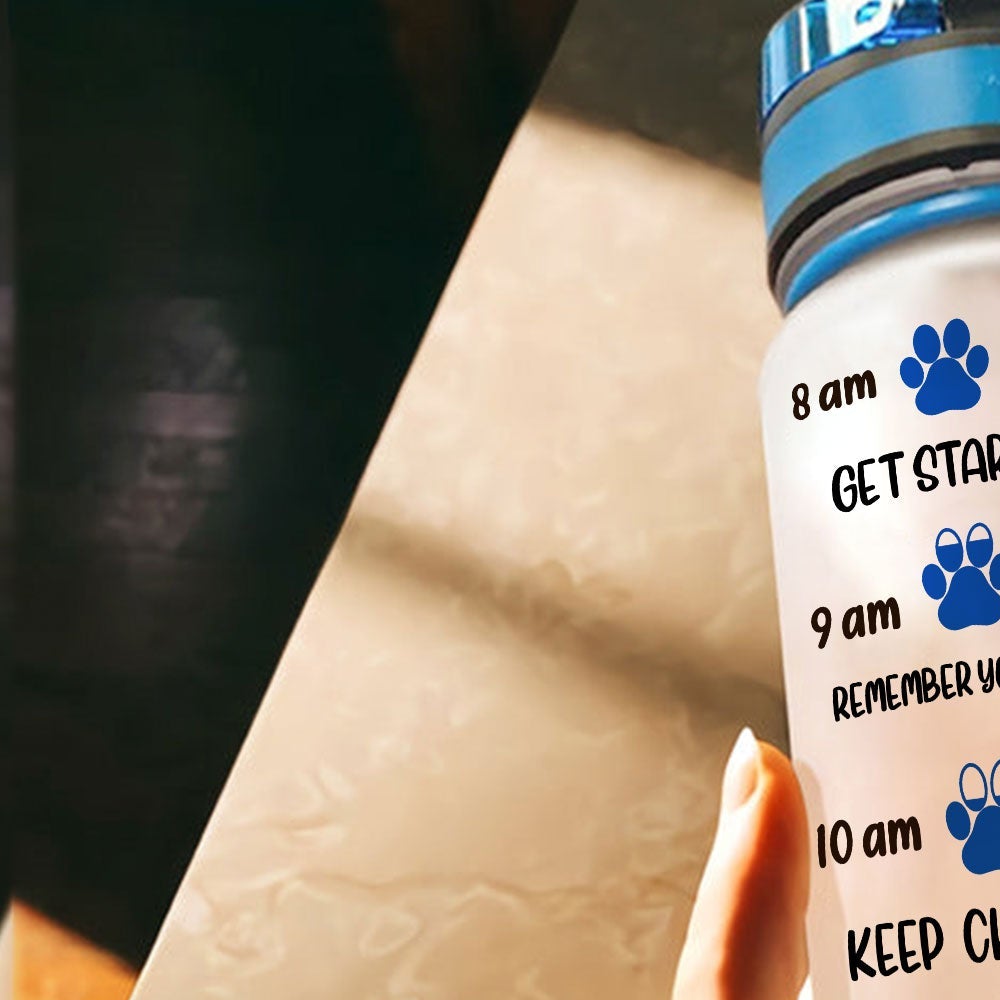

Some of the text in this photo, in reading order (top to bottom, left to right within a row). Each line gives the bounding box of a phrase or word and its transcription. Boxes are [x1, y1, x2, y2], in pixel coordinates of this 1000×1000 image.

[831, 450, 905, 513] GET
[832, 660, 974, 723] REMEMBER
[847, 916, 945, 982] KEEP
